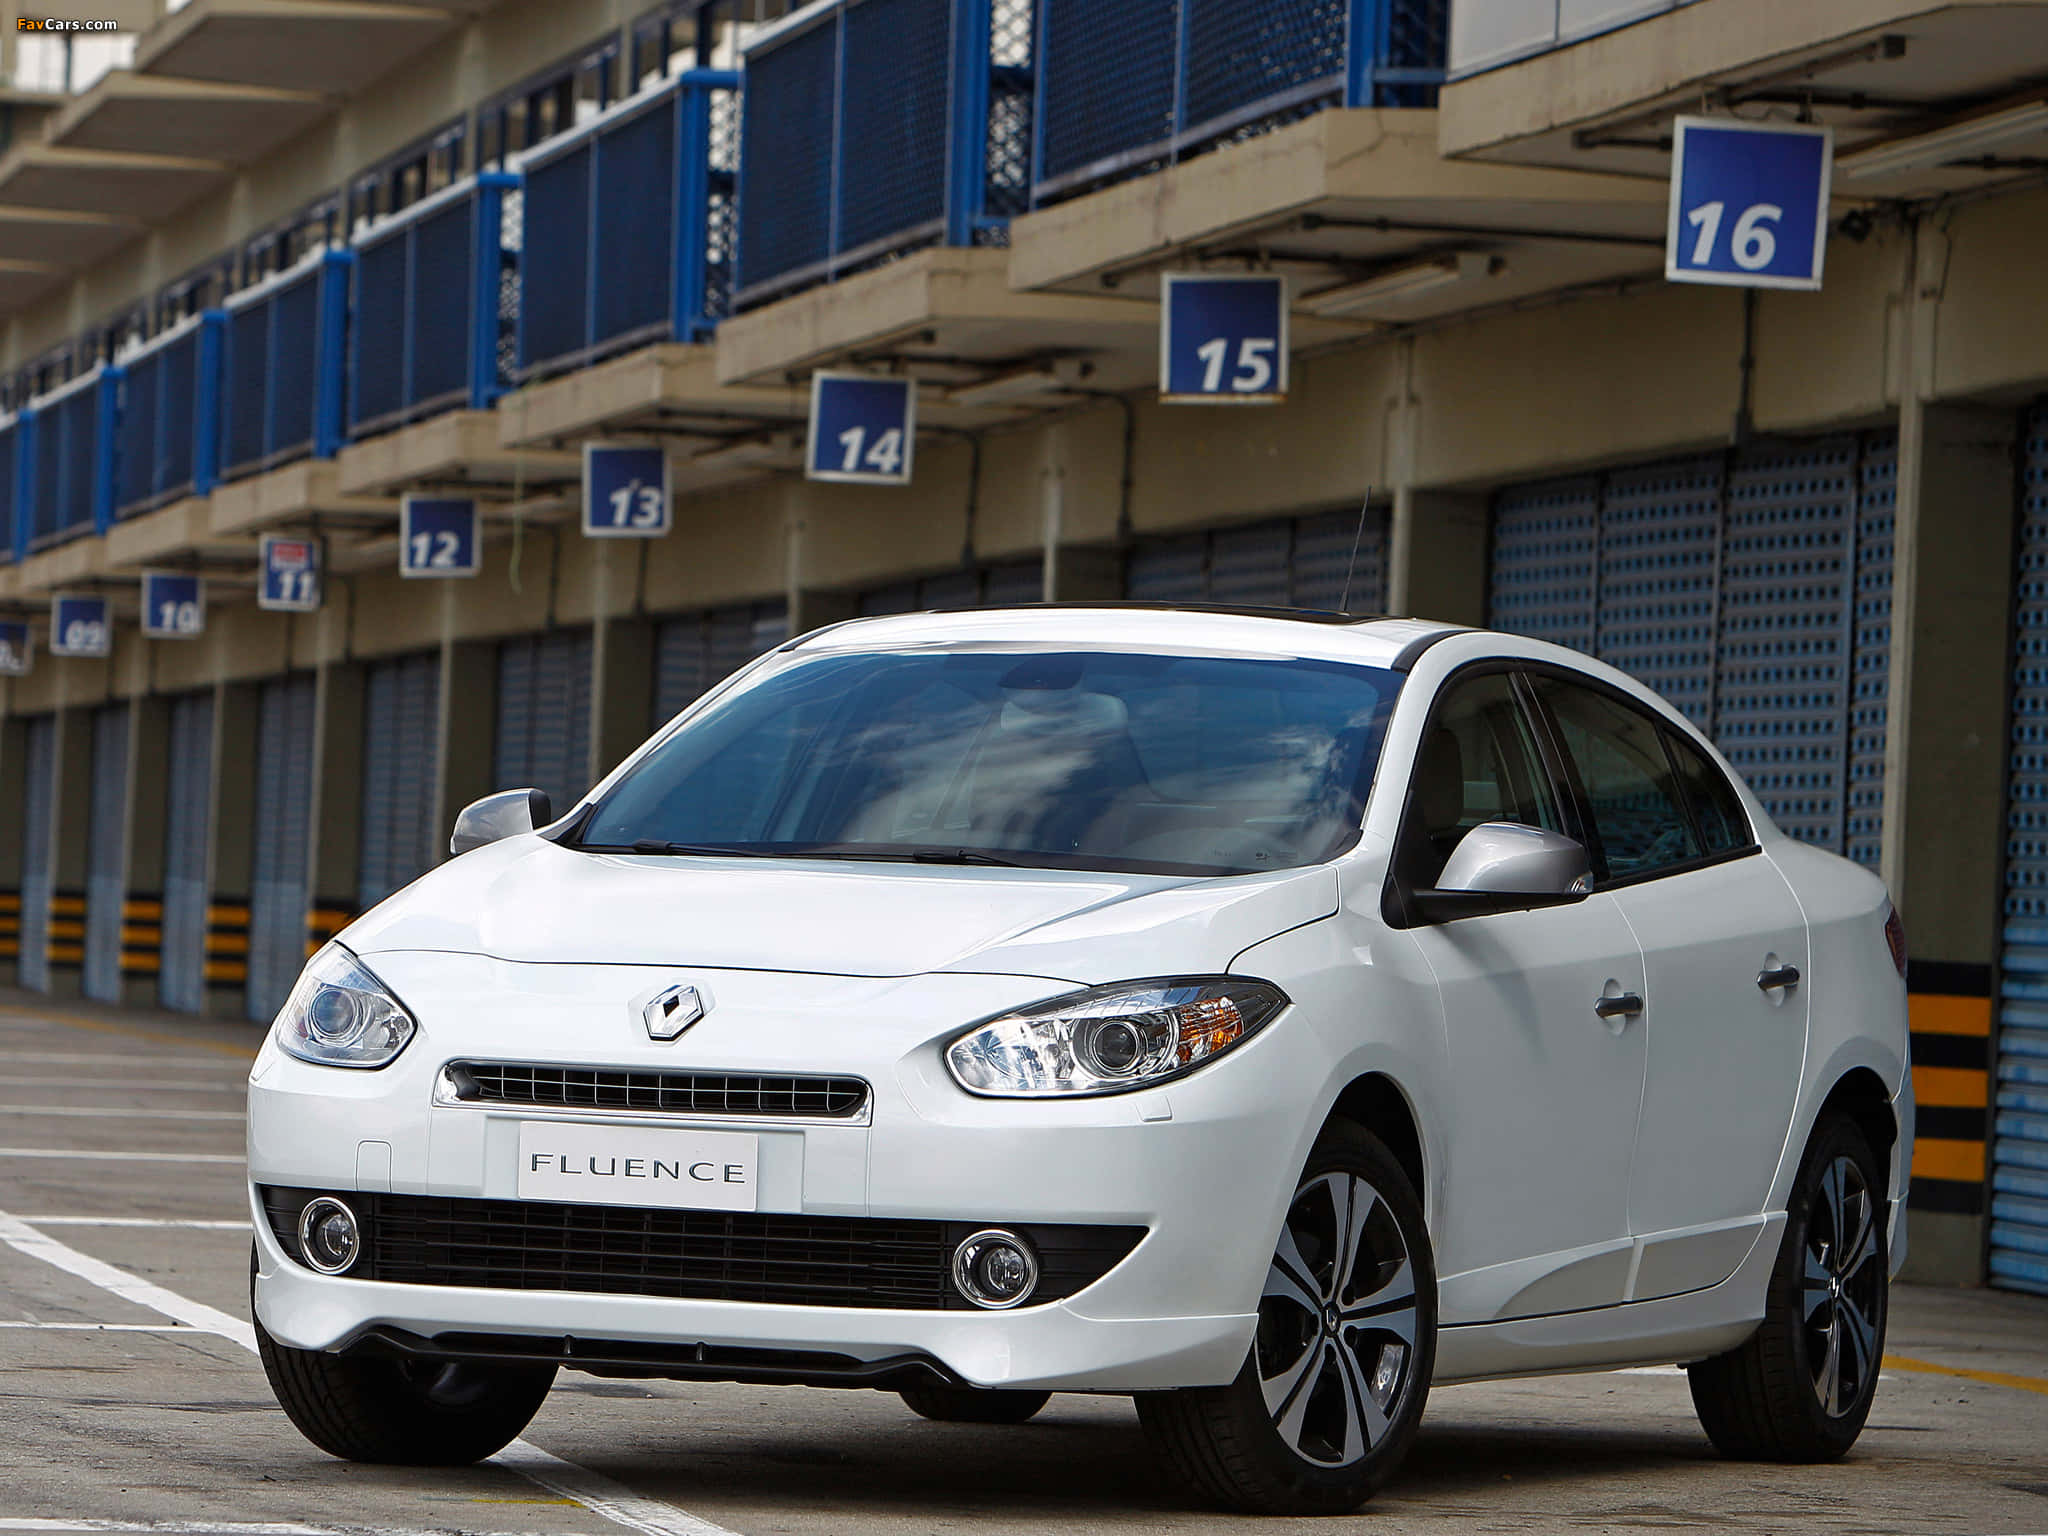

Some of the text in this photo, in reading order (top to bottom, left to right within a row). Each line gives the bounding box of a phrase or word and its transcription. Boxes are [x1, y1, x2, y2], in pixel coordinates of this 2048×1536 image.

[1687, 202, 1782, 271] 16
[1198, 338, 1275, 392] 15
[838, 427, 902, 473] 14
[609, 487, 664, 527] 13
[412, 532, 459, 567] 12
[279, 571, 314, 600] 11
[158, 602, 200, 632] 10
[531, 1153, 746, 1184] FLUENCE
